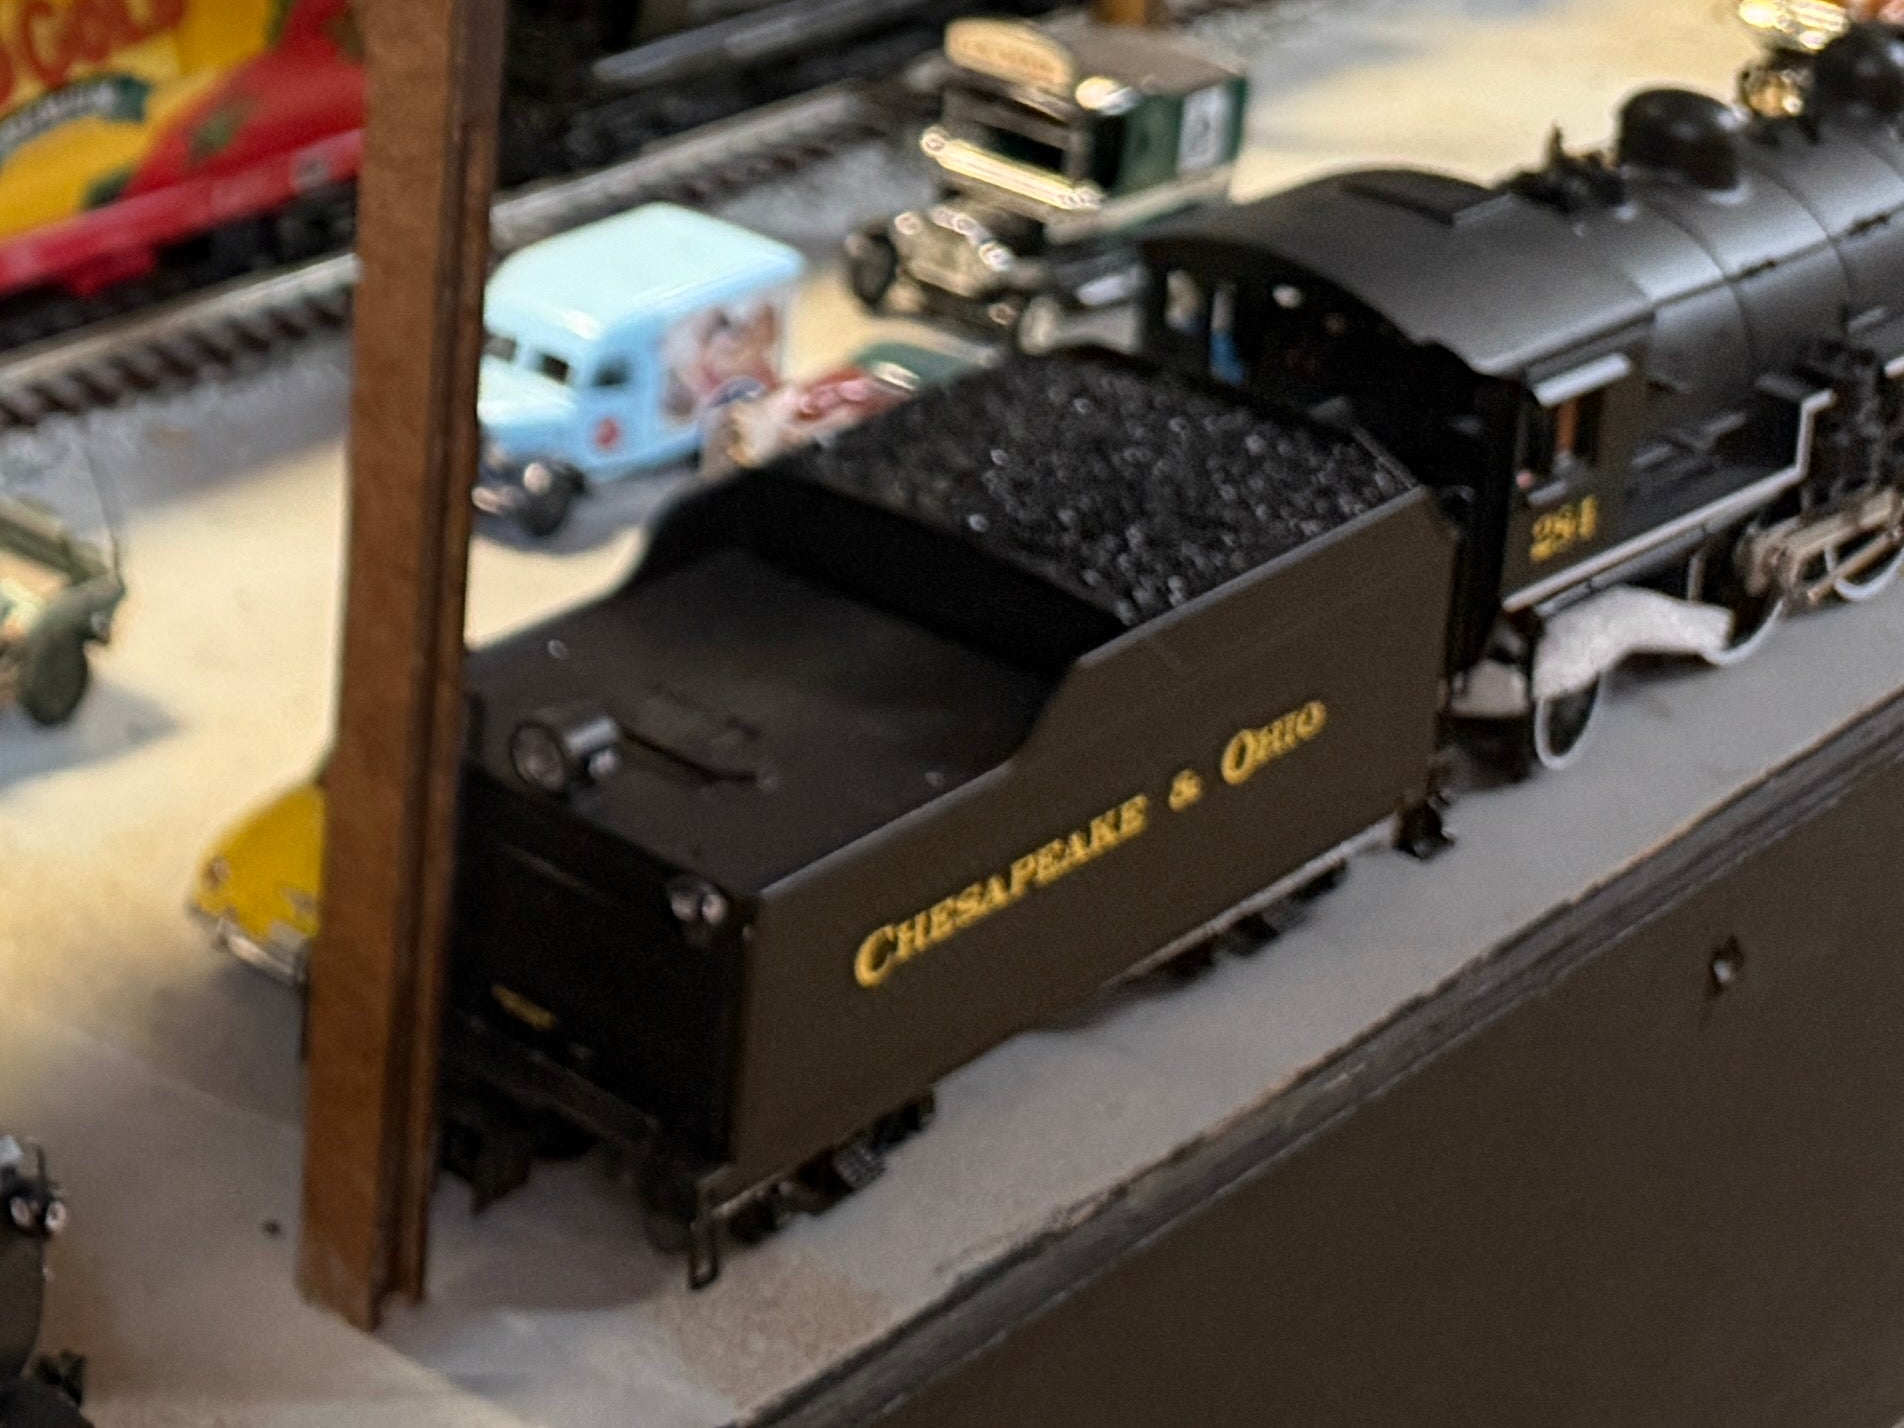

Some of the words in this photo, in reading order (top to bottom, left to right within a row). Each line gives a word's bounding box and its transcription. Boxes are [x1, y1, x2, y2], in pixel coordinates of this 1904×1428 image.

[854, 794, 1149, 987] CHESAPEAKE
[1168, 769, 1202, 812] &
[1221, 701, 1326, 785] OHIO
